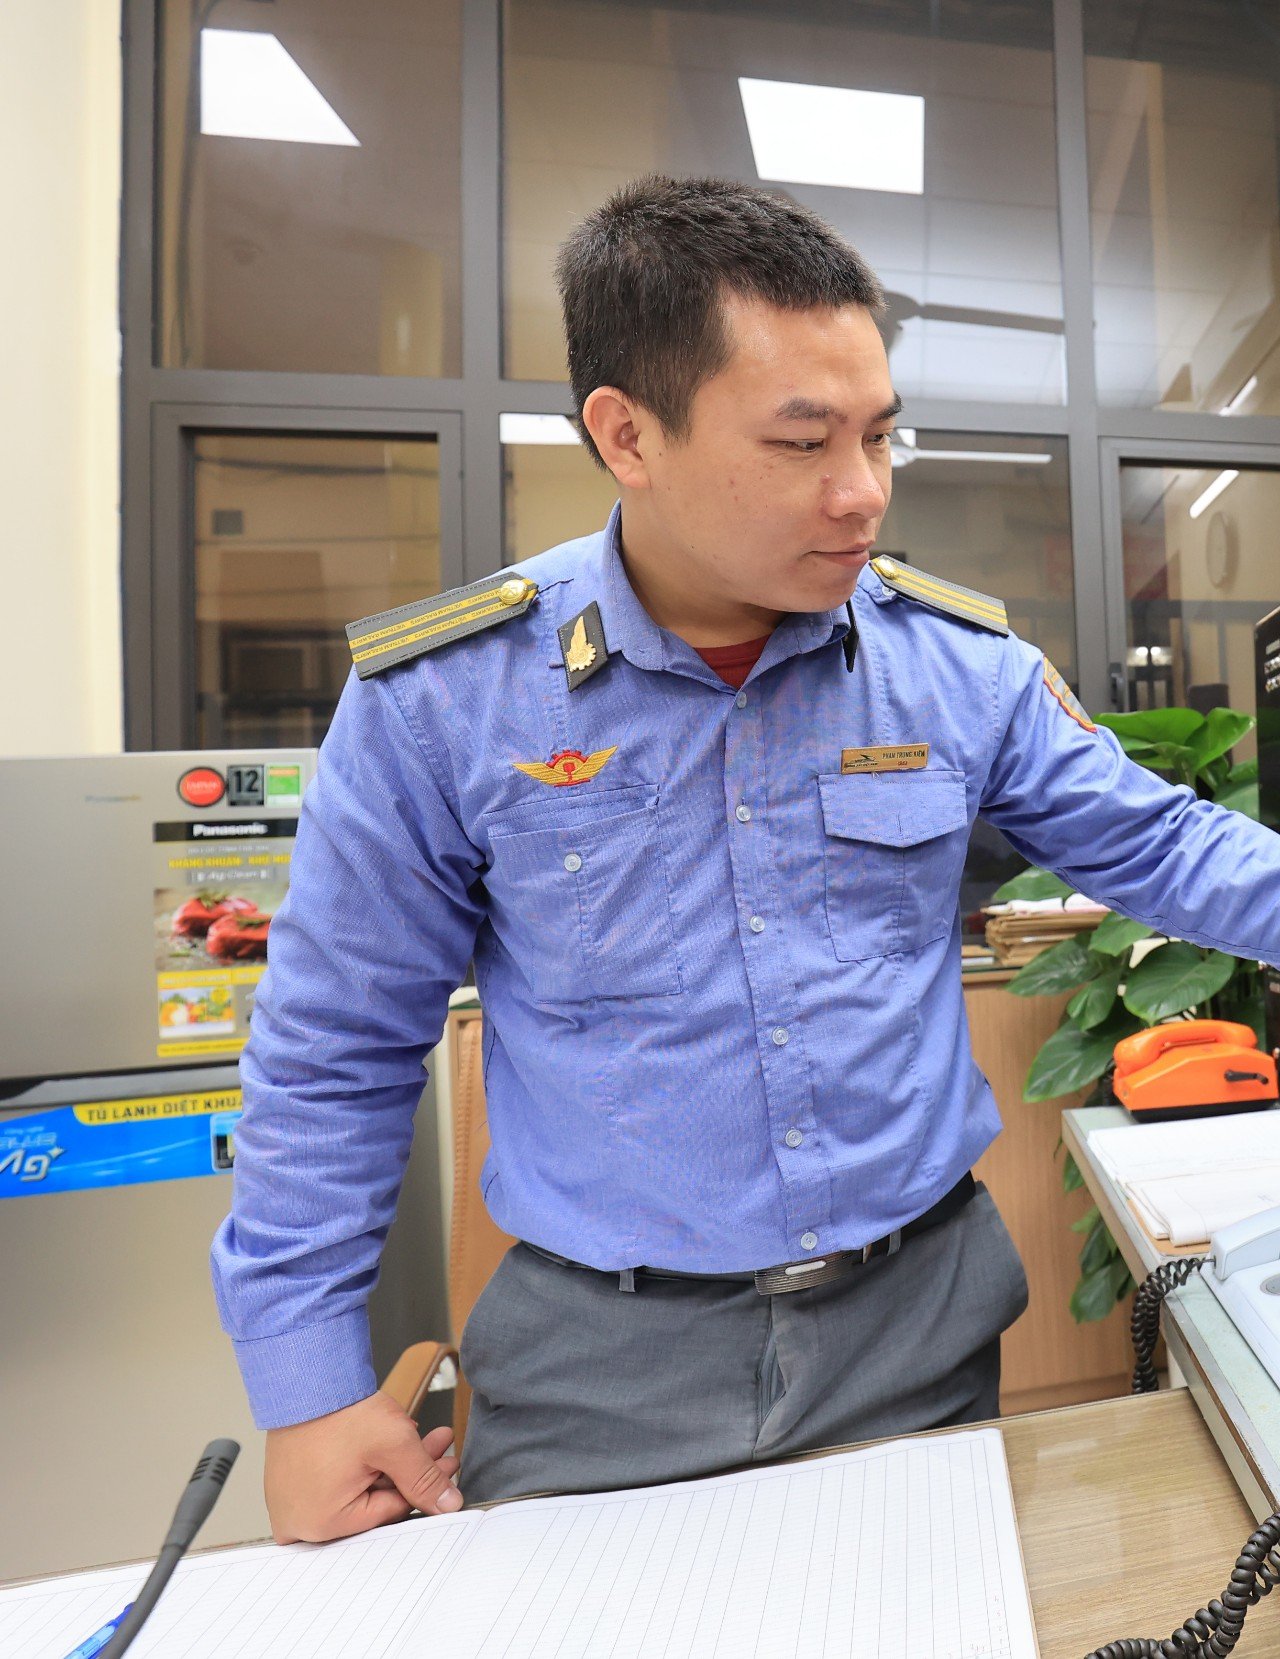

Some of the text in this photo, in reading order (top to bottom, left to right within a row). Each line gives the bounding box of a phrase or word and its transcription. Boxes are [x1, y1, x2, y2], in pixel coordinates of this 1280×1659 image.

[233, 770, 259, 793] 12
[192, 822, 268, 837] Panasonic
[203, 1095, 242, 1110] KHU
